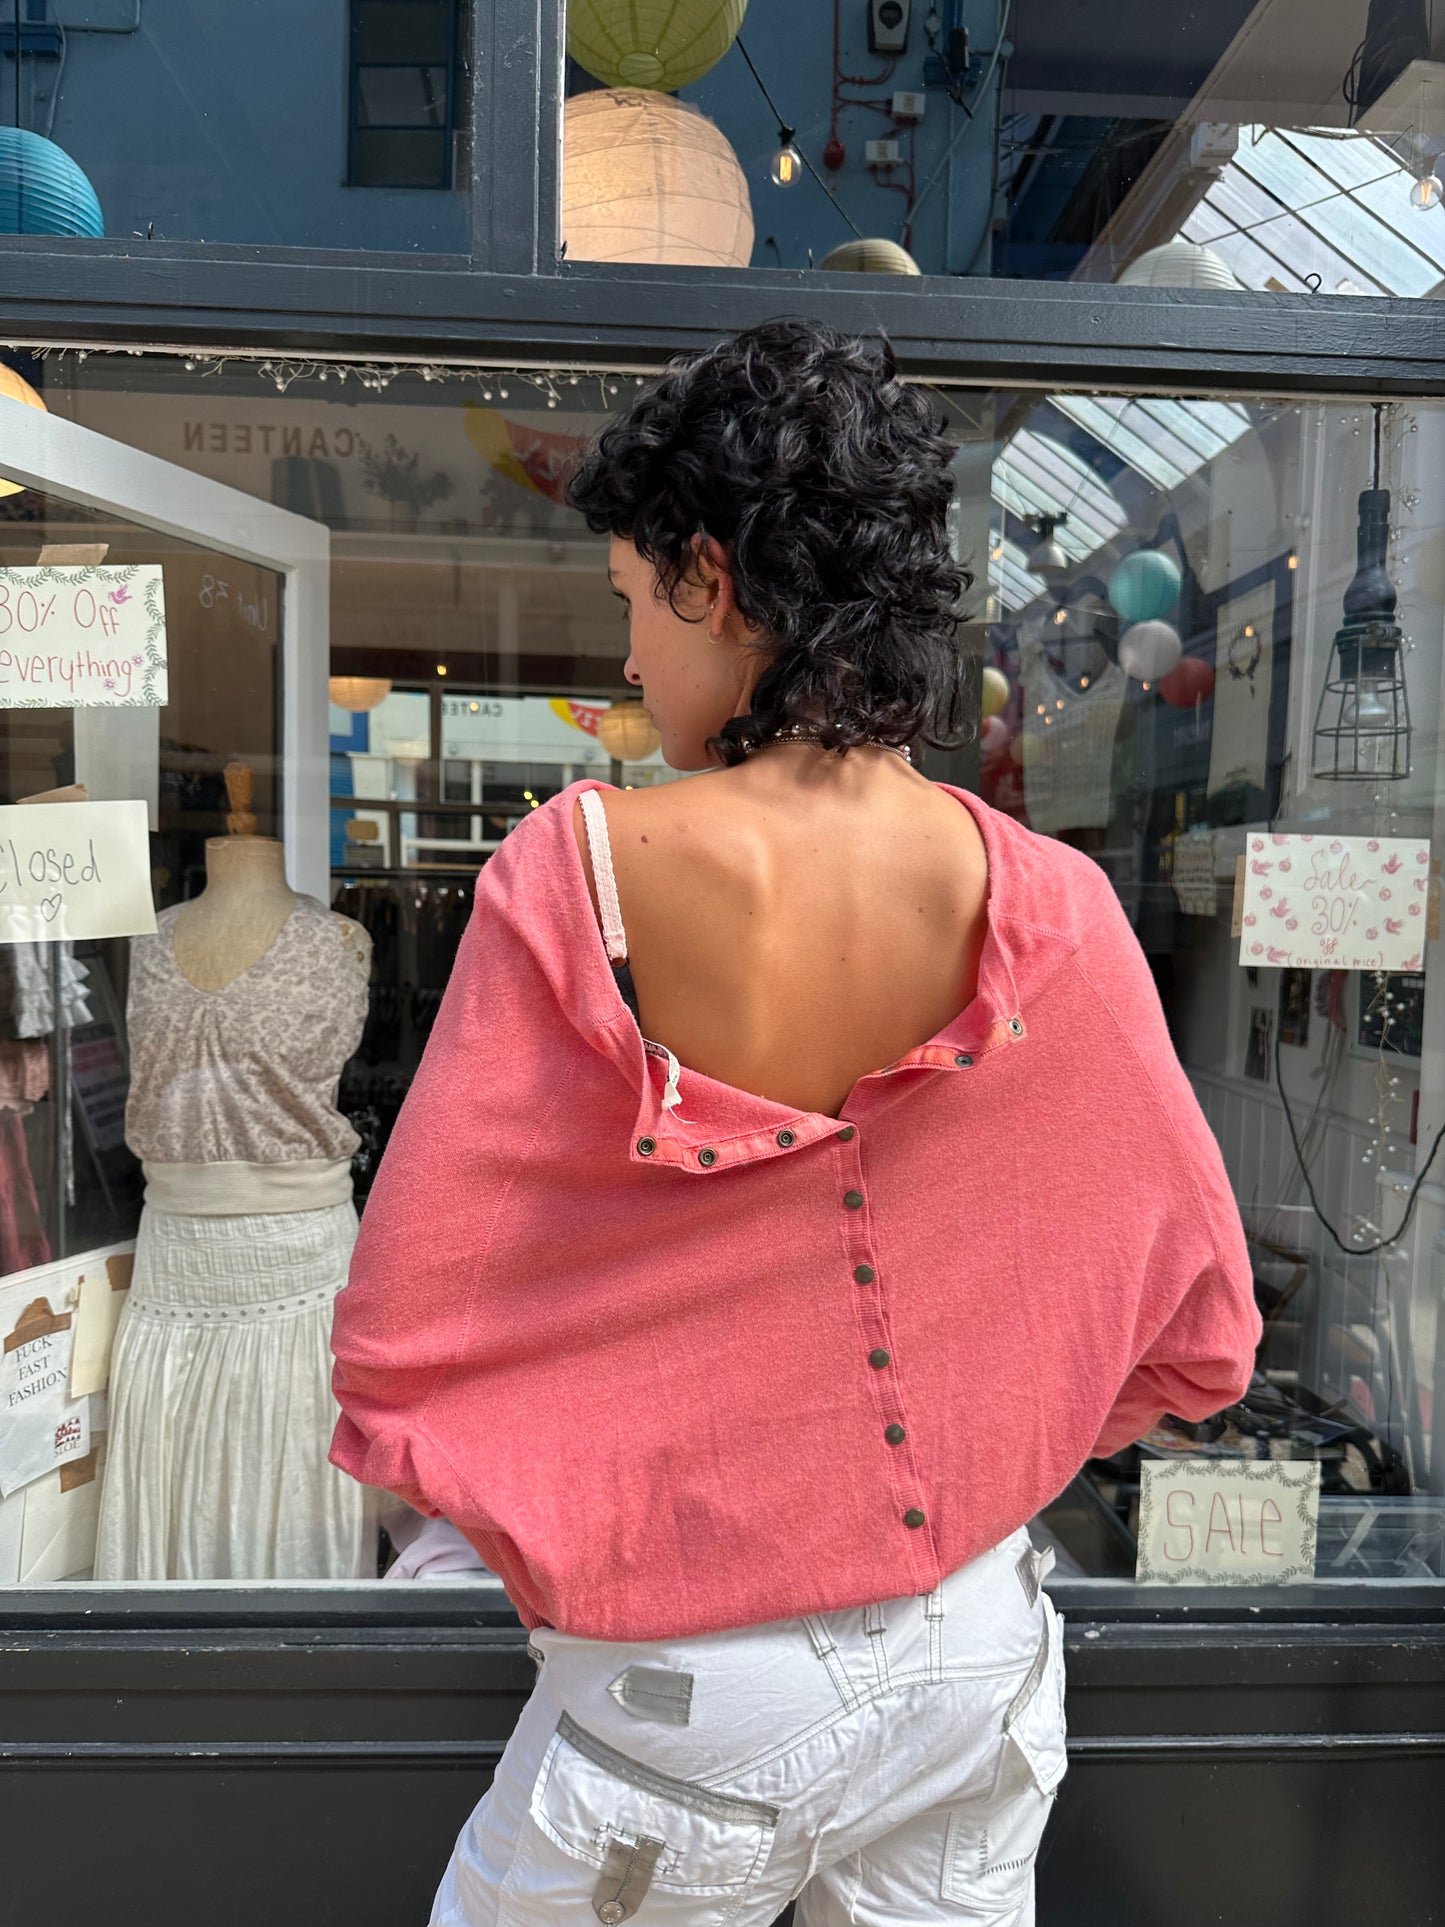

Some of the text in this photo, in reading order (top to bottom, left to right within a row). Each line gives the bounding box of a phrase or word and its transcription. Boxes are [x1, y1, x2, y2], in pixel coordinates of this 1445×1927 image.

[73, 588, 120, 637] Off
[0, 649, 132, 698] everything
[1303, 848, 1377, 892] Sale
[1311, 894, 1360, 936] 30%
[1319, 937, 1340, 957] off
[15, 1335, 53, 1363] FUCK
[18, 1354, 52, 1381] FAST
[8, 1366, 68, 1407] FASHION
